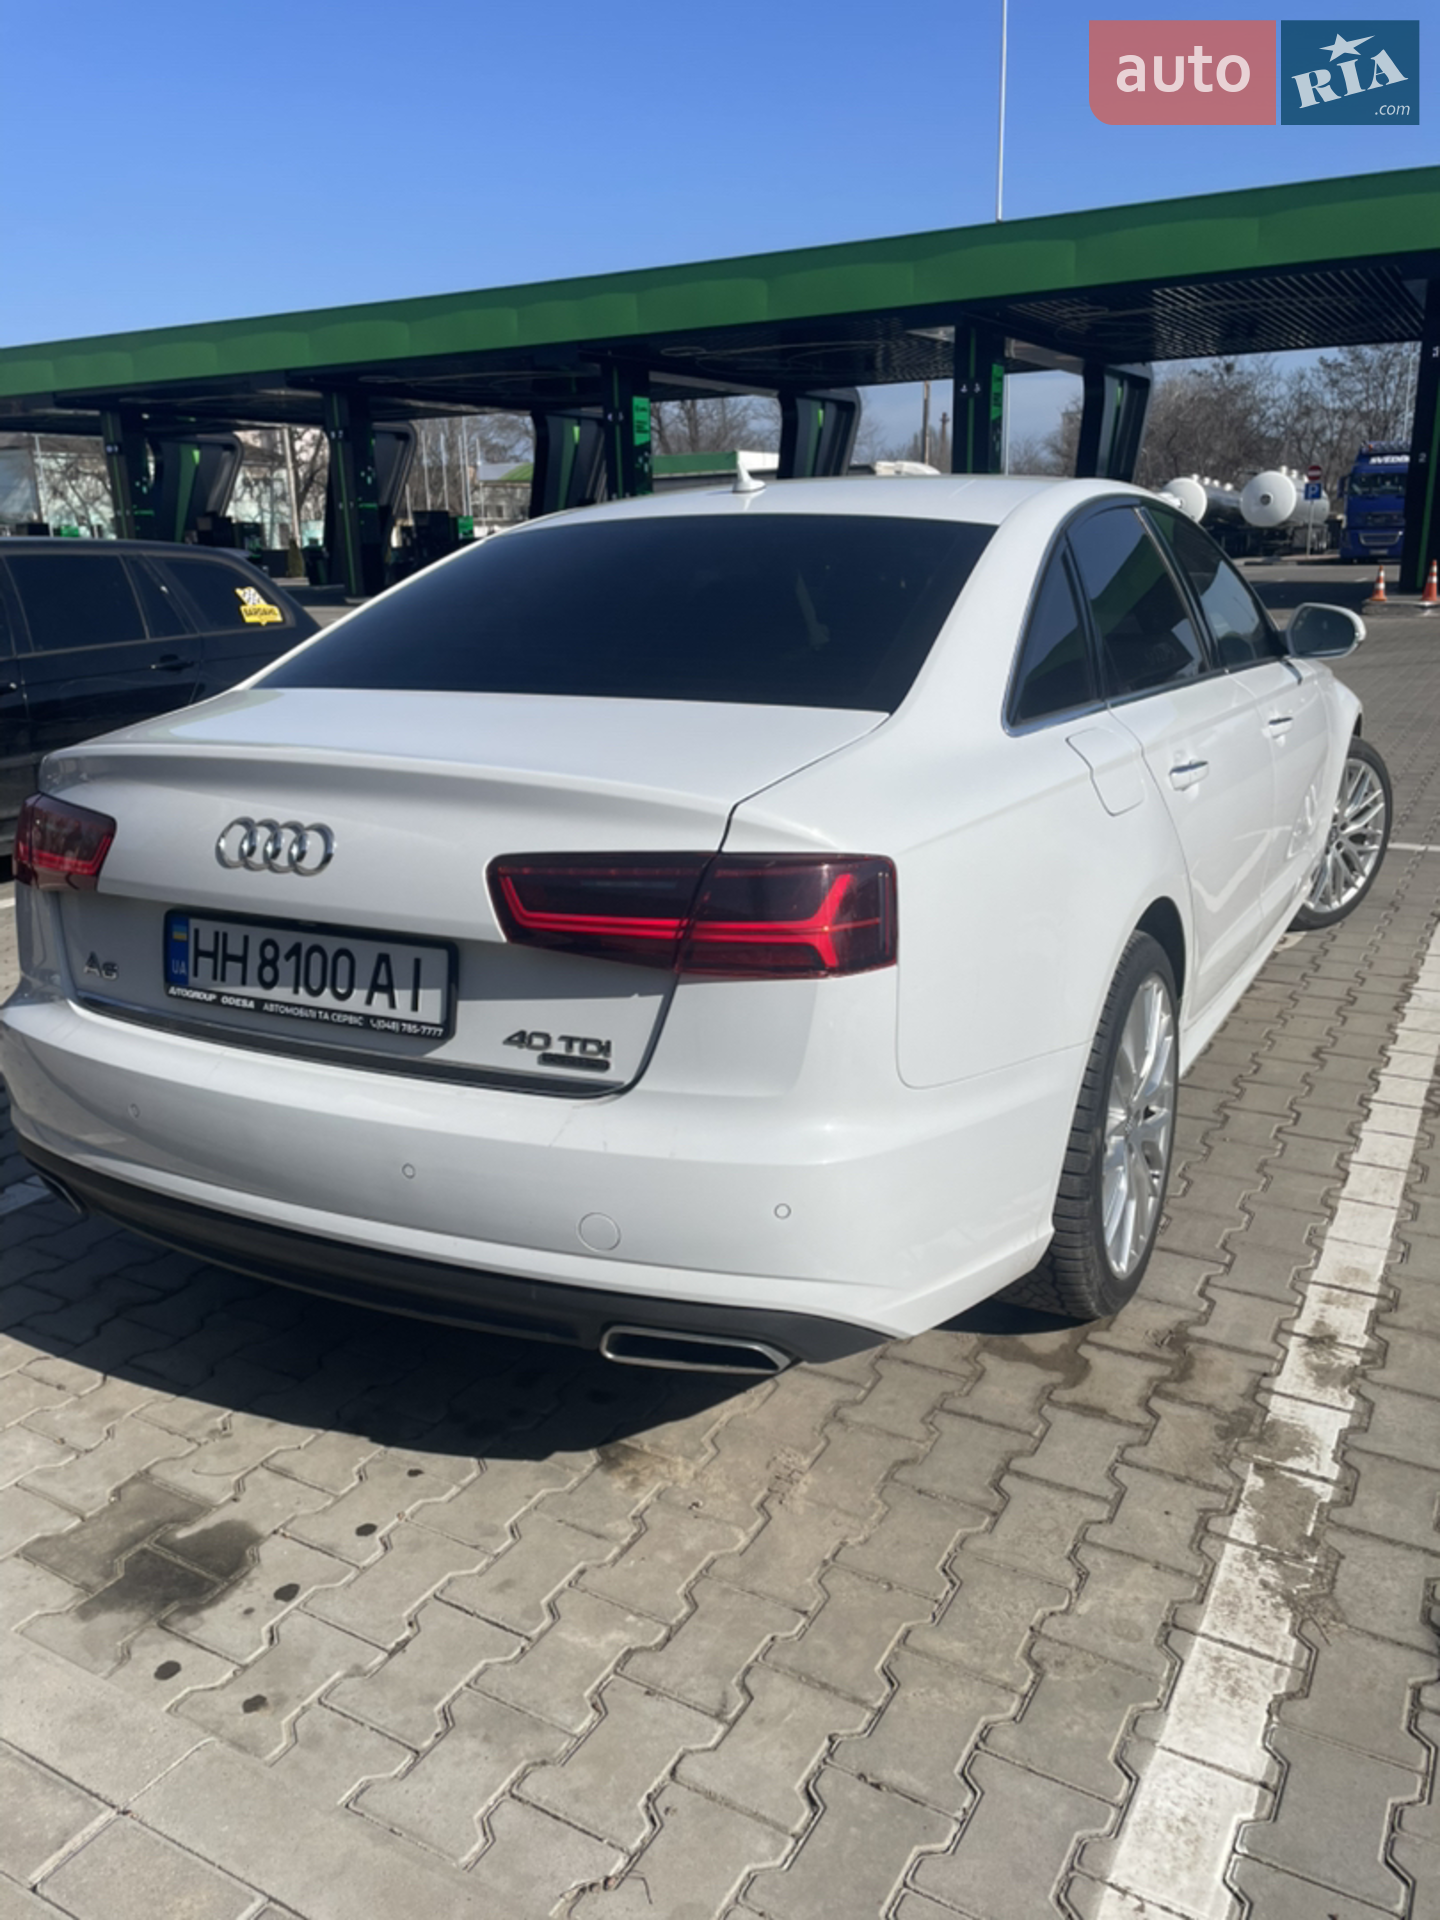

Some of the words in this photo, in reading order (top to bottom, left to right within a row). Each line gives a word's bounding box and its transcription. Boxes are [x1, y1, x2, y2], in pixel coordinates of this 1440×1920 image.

[83, 950, 119, 980] A6
[171, 959, 187, 975] UA
[502, 1029, 552, 1051] 40
[557, 1035, 612, 1058] TDI
